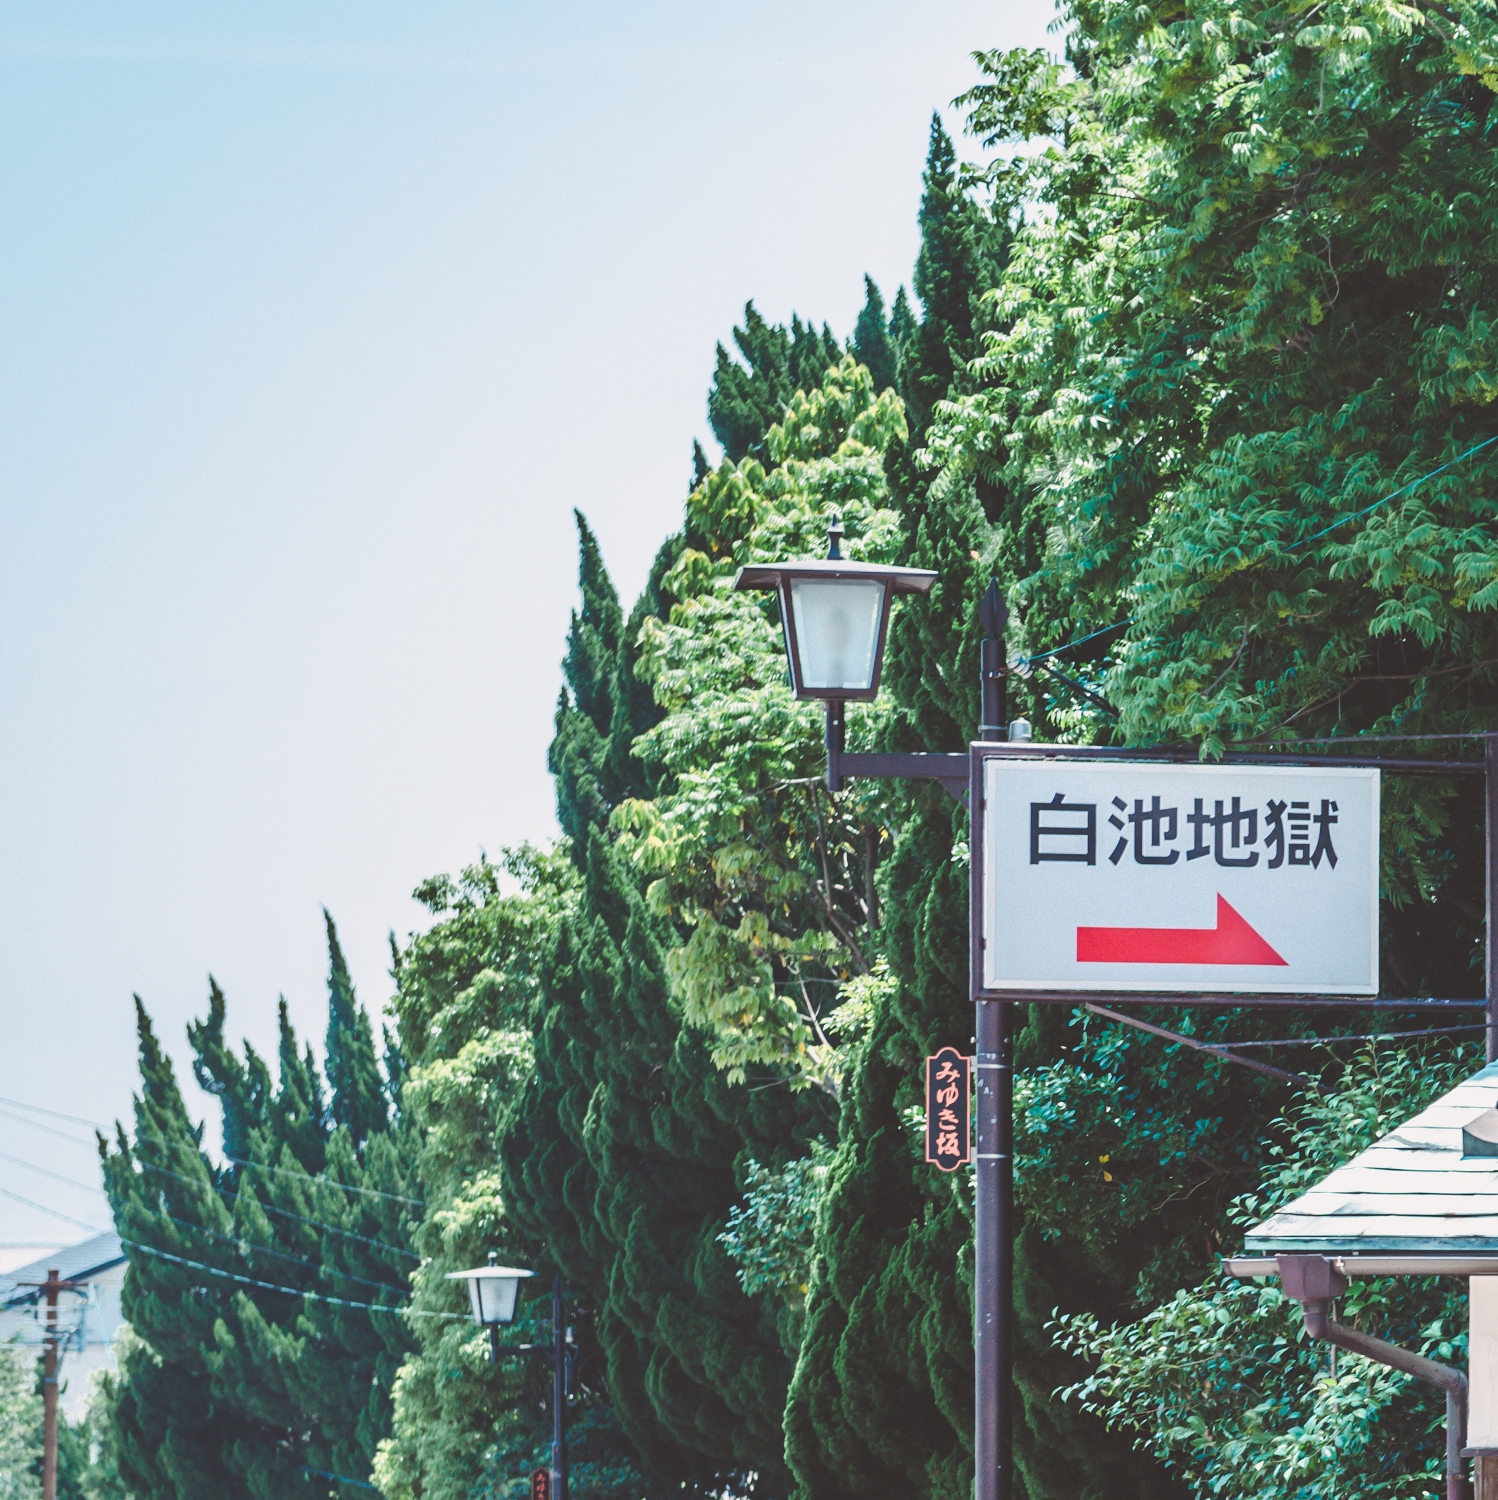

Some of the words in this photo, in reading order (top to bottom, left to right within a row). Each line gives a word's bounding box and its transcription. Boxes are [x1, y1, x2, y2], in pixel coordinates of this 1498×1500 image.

[1029, 793, 1339, 869] 白池地獄
[936, 1061, 960, 1157] みゆき坂
